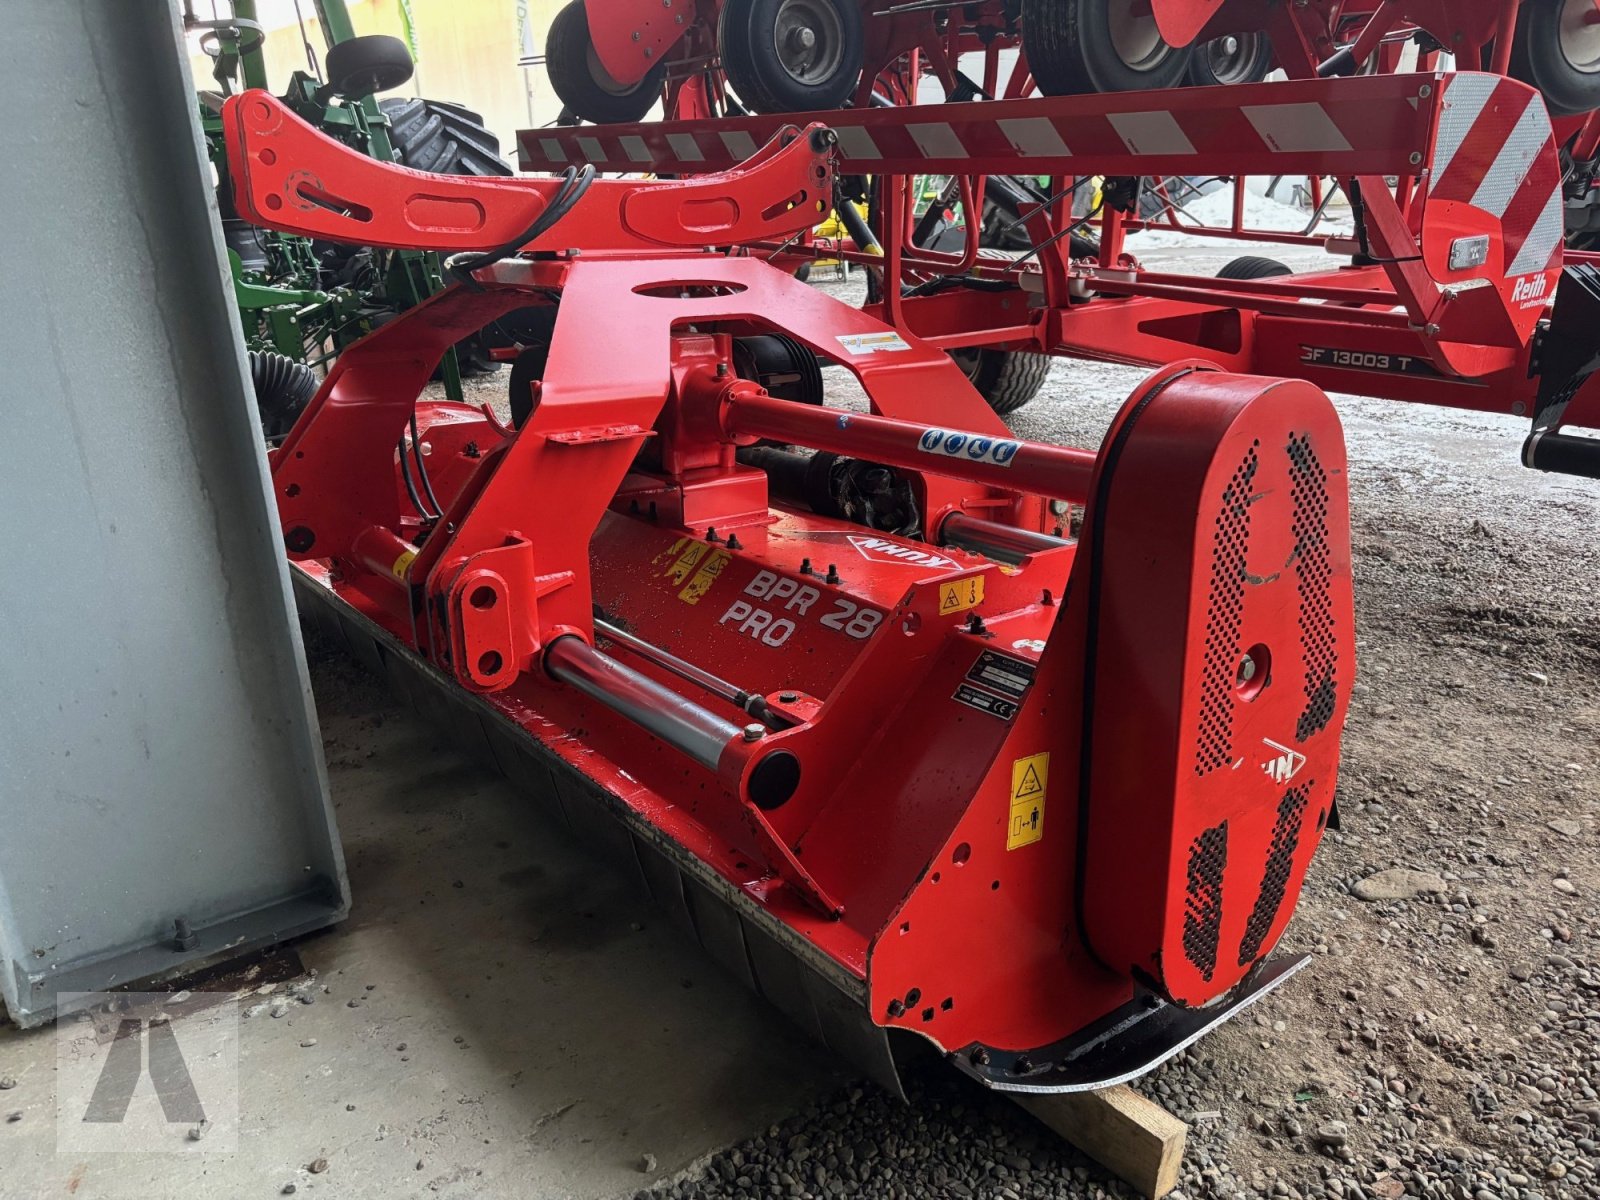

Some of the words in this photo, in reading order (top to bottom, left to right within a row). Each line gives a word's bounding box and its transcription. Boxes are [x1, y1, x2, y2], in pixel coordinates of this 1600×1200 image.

[1511, 273, 1547, 303] Reith
[1332, 351, 1390, 369] 13003
[1397, 357, 1412, 370] T
[855, 538, 952, 567] KUHN
[743, 569, 821, 616] BPR
[819, 599, 884, 639] 28
[719, 600, 796, 647] PRO
